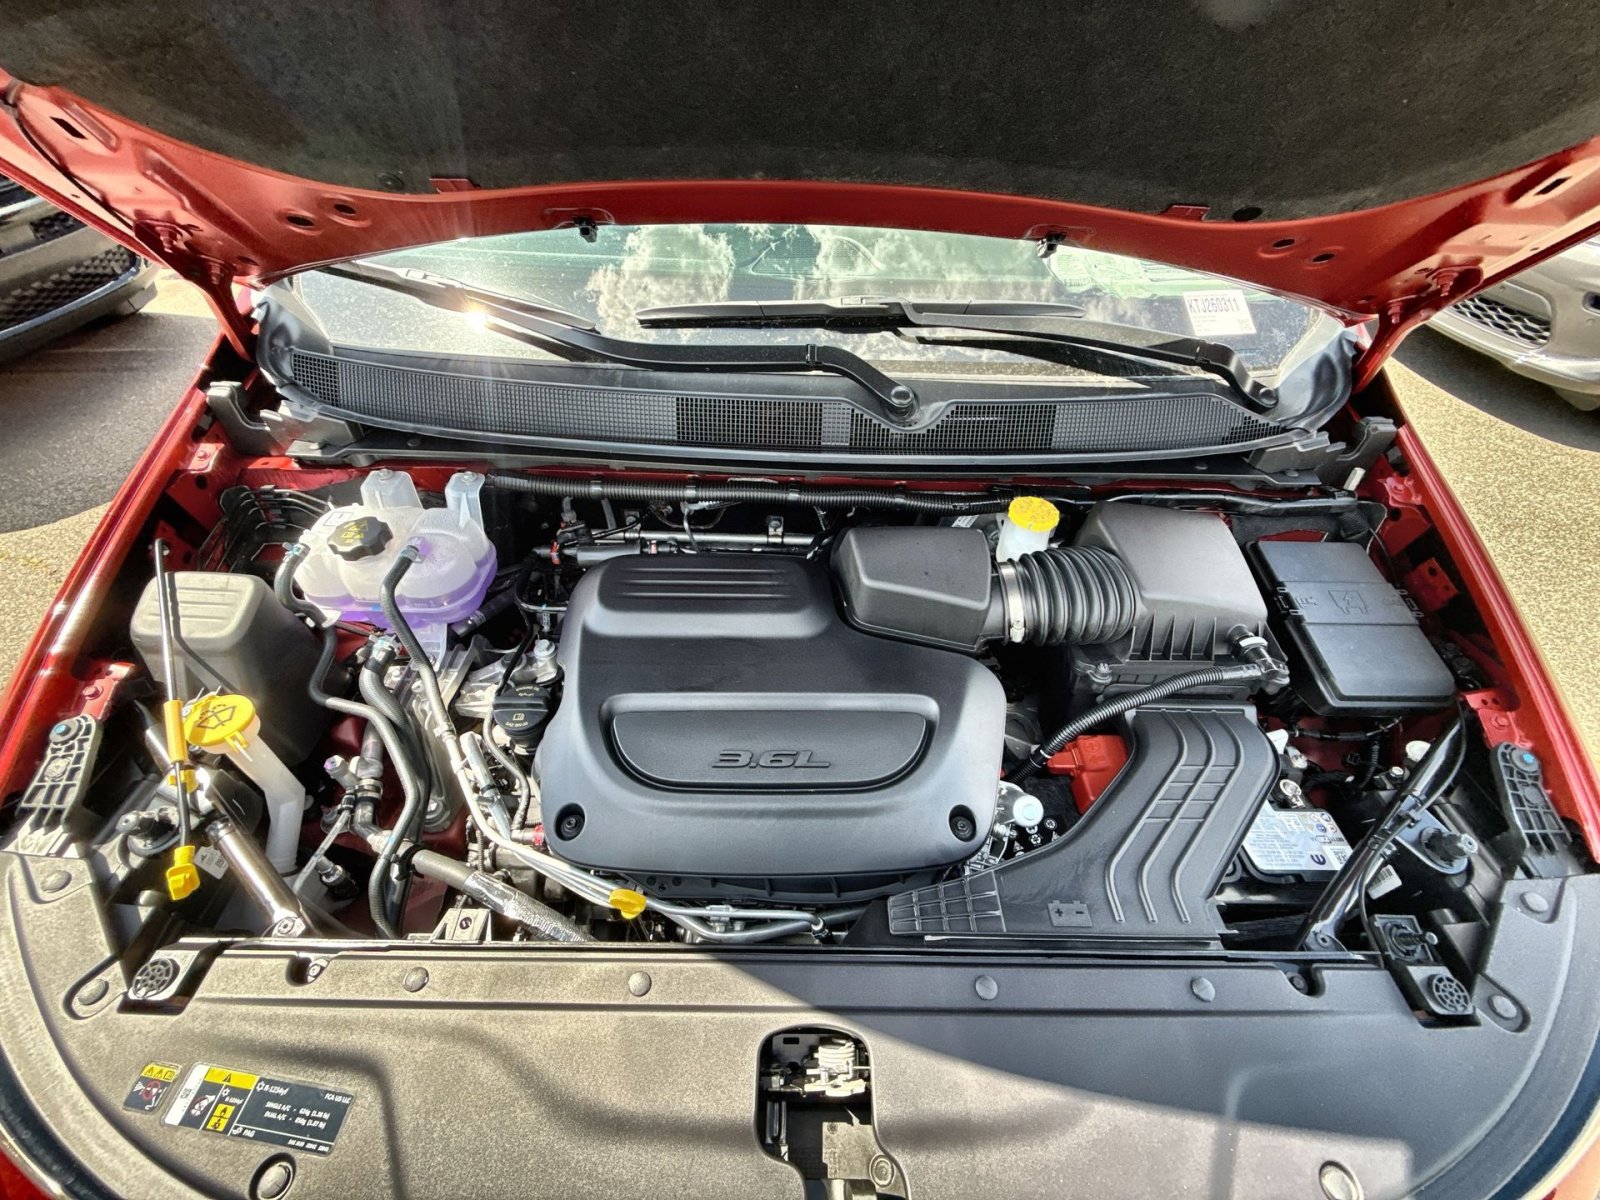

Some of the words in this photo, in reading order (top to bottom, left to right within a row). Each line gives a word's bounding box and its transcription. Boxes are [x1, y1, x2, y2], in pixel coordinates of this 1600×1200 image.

[711, 749, 832, 769] 3.6L
[324, 1092, 335, 1101] FCA
[242, 1129, 256, 1138] PAG
